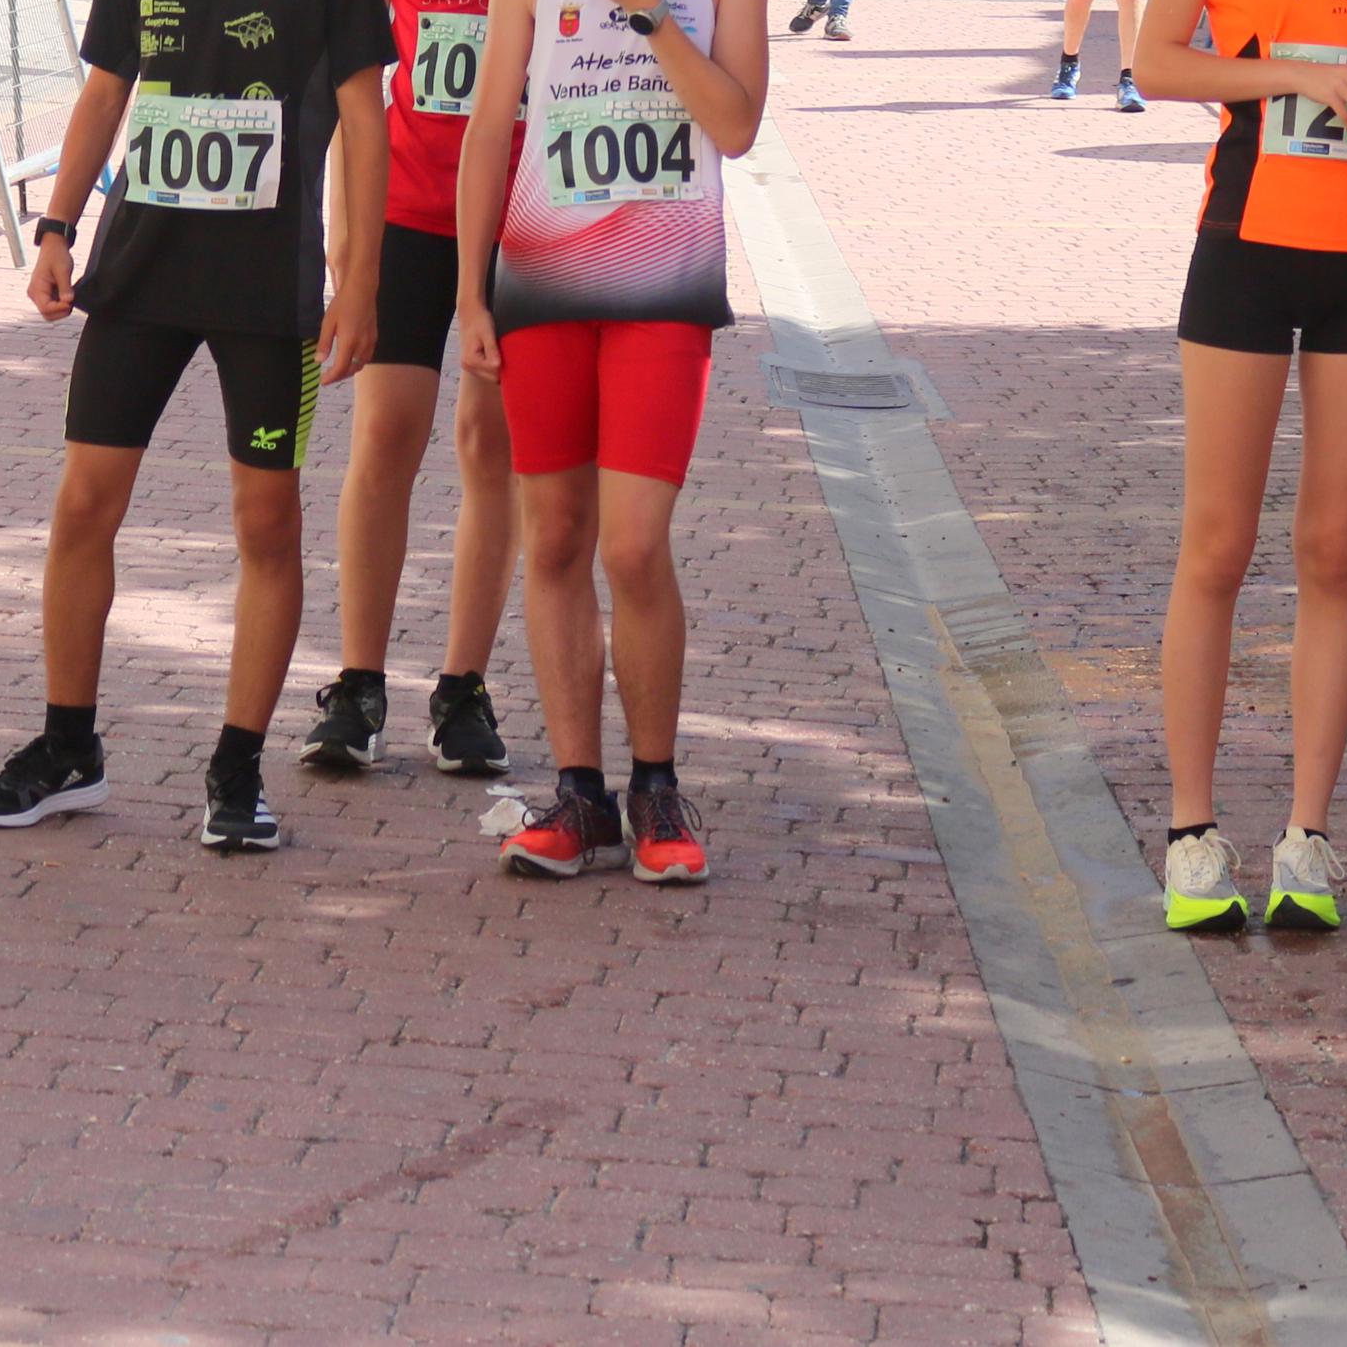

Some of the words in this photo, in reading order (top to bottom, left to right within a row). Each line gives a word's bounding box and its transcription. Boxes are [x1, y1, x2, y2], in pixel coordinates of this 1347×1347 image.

[417, 41, 477, 100] 10
[550, 82, 598, 100] Venta
[1272, 93, 1345, 141] 12
[129, 125, 275, 193] 1007
[547, 122, 696, 189] 1004
